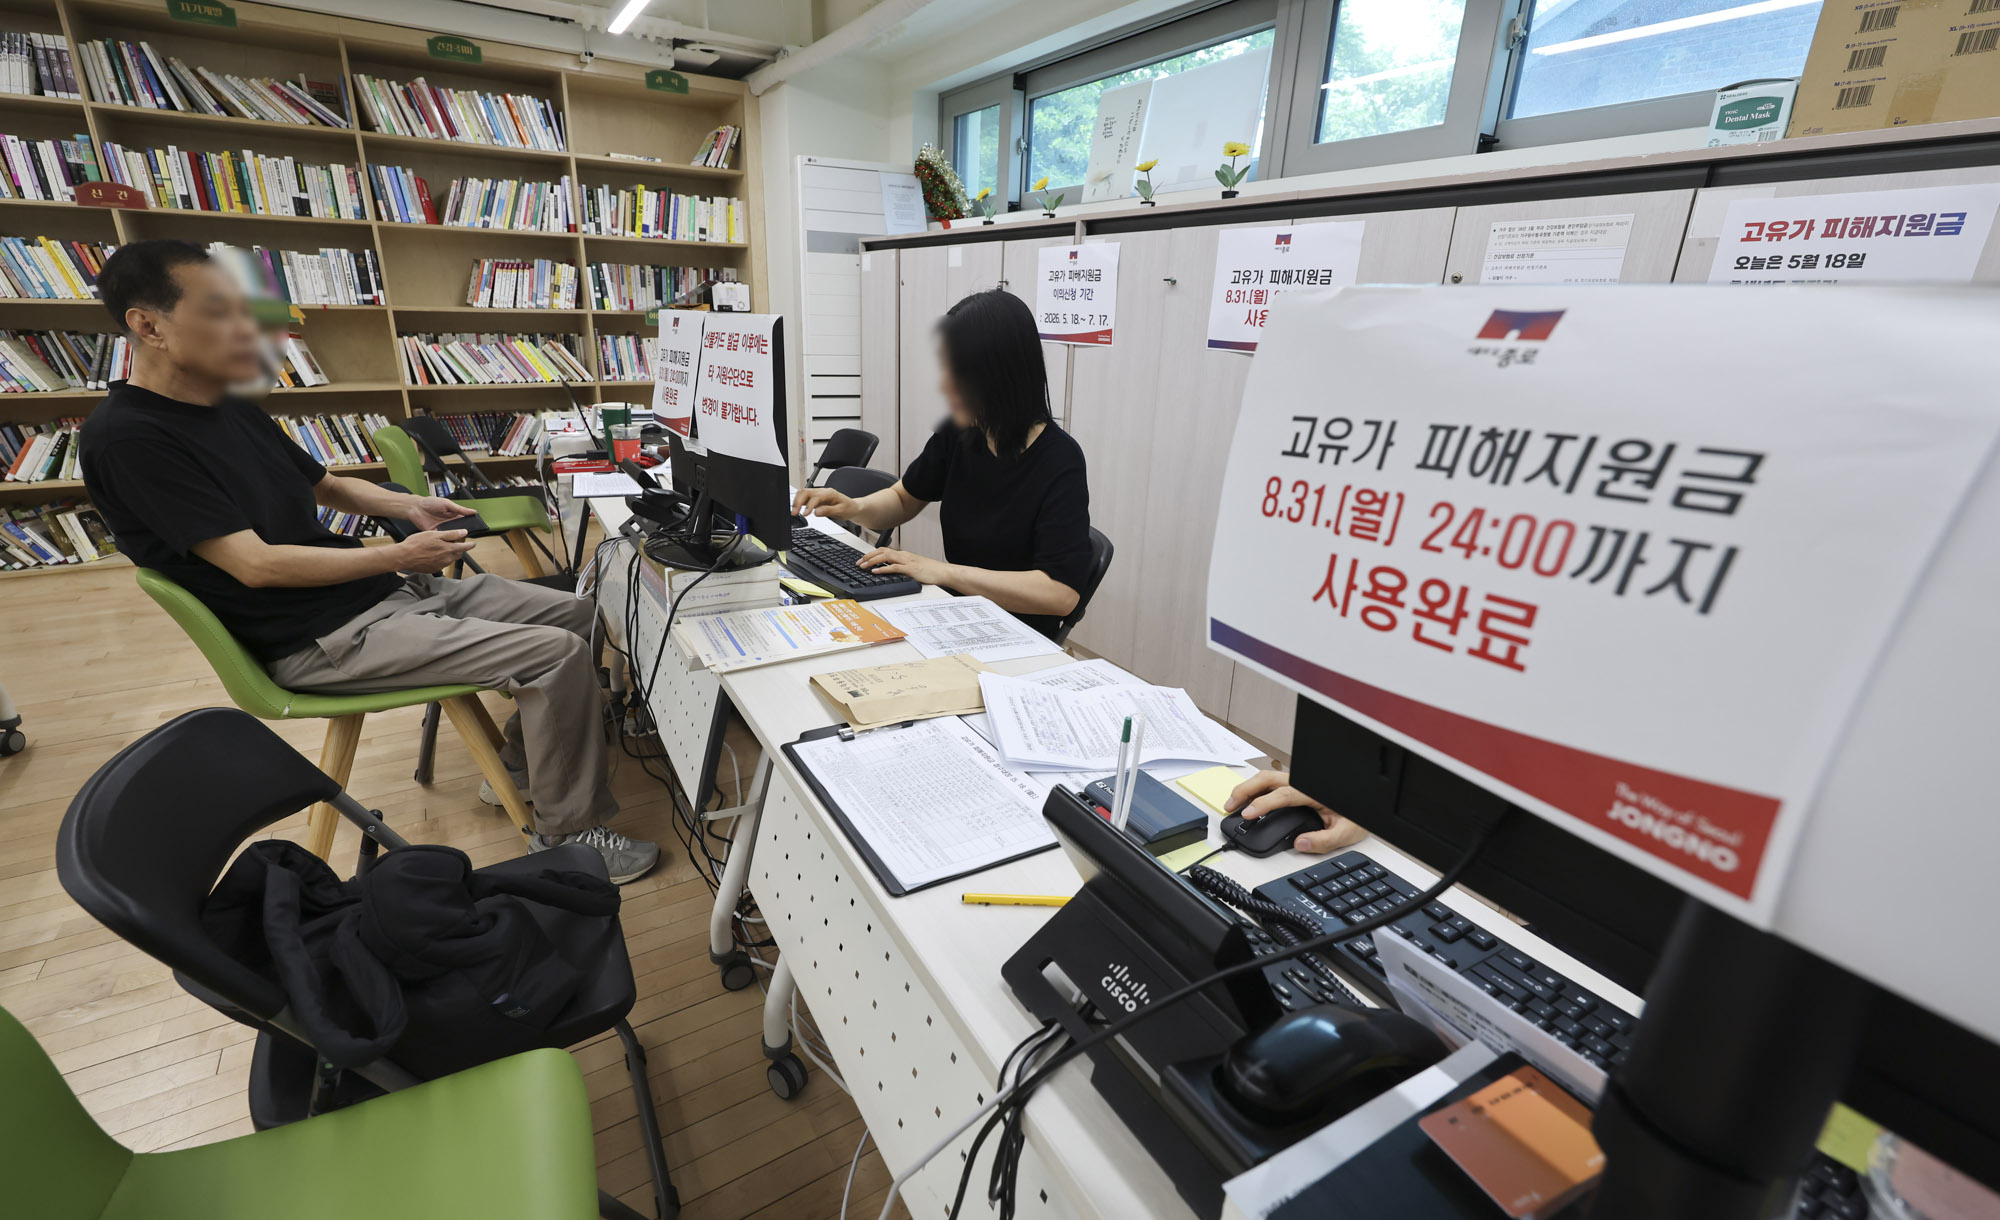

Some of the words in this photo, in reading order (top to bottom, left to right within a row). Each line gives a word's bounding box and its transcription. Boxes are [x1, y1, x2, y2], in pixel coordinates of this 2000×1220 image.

[1724, 114, 1749, 124] Dental
[1750, 111, 1771, 120] Mask
[1740, 218, 1815, 242] 고유가
[1820, 211, 1968, 240] 피해지원금
[1733, 254, 1784, 270] 오늘은
[1787, 253, 1820, 270] 5월
[1824, 252, 1867, 269] 18일
[1048, 270, 1066, 282] 고유가
[1068, 268, 1102, 282] 피해지원금
[1231, 270, 1264, 285] 고유가
[1269, 269, 1332, 285] 피해지원금
[1053, 288, 1077, 301] 이의신청
[1080, 288, 1094, 301] 기간
[1044, 312, 1061, 324] 2026.
[1088, 314, 1095, 326] 7.
[1099, 314, 1109, 326] 17.
[704, 331, 726, 349] 선불카드
[727, 332, 740, 351] 발급
[741, 333, 768, 355] 이후에는
[708, 364, 714, 382] 타
[716, 366, 754, 388] 지원수단으로
[702, 397, 719, 417] 변경이
[721, 401, 759, 427] 불가합니다.
[1281, 415, 1398, 471] 고유가
[1415, 423, 1767, 517] 피해지원금
[1420, 500, 1740, 616] 24:00까지
[1312, 553, 1539, 672] 사용완료
[1606, 800, 1740, 873] JONGNO
[1296, 895, 1333, 919] ATEC
[1101, 976, 1137, 1012] cisco
